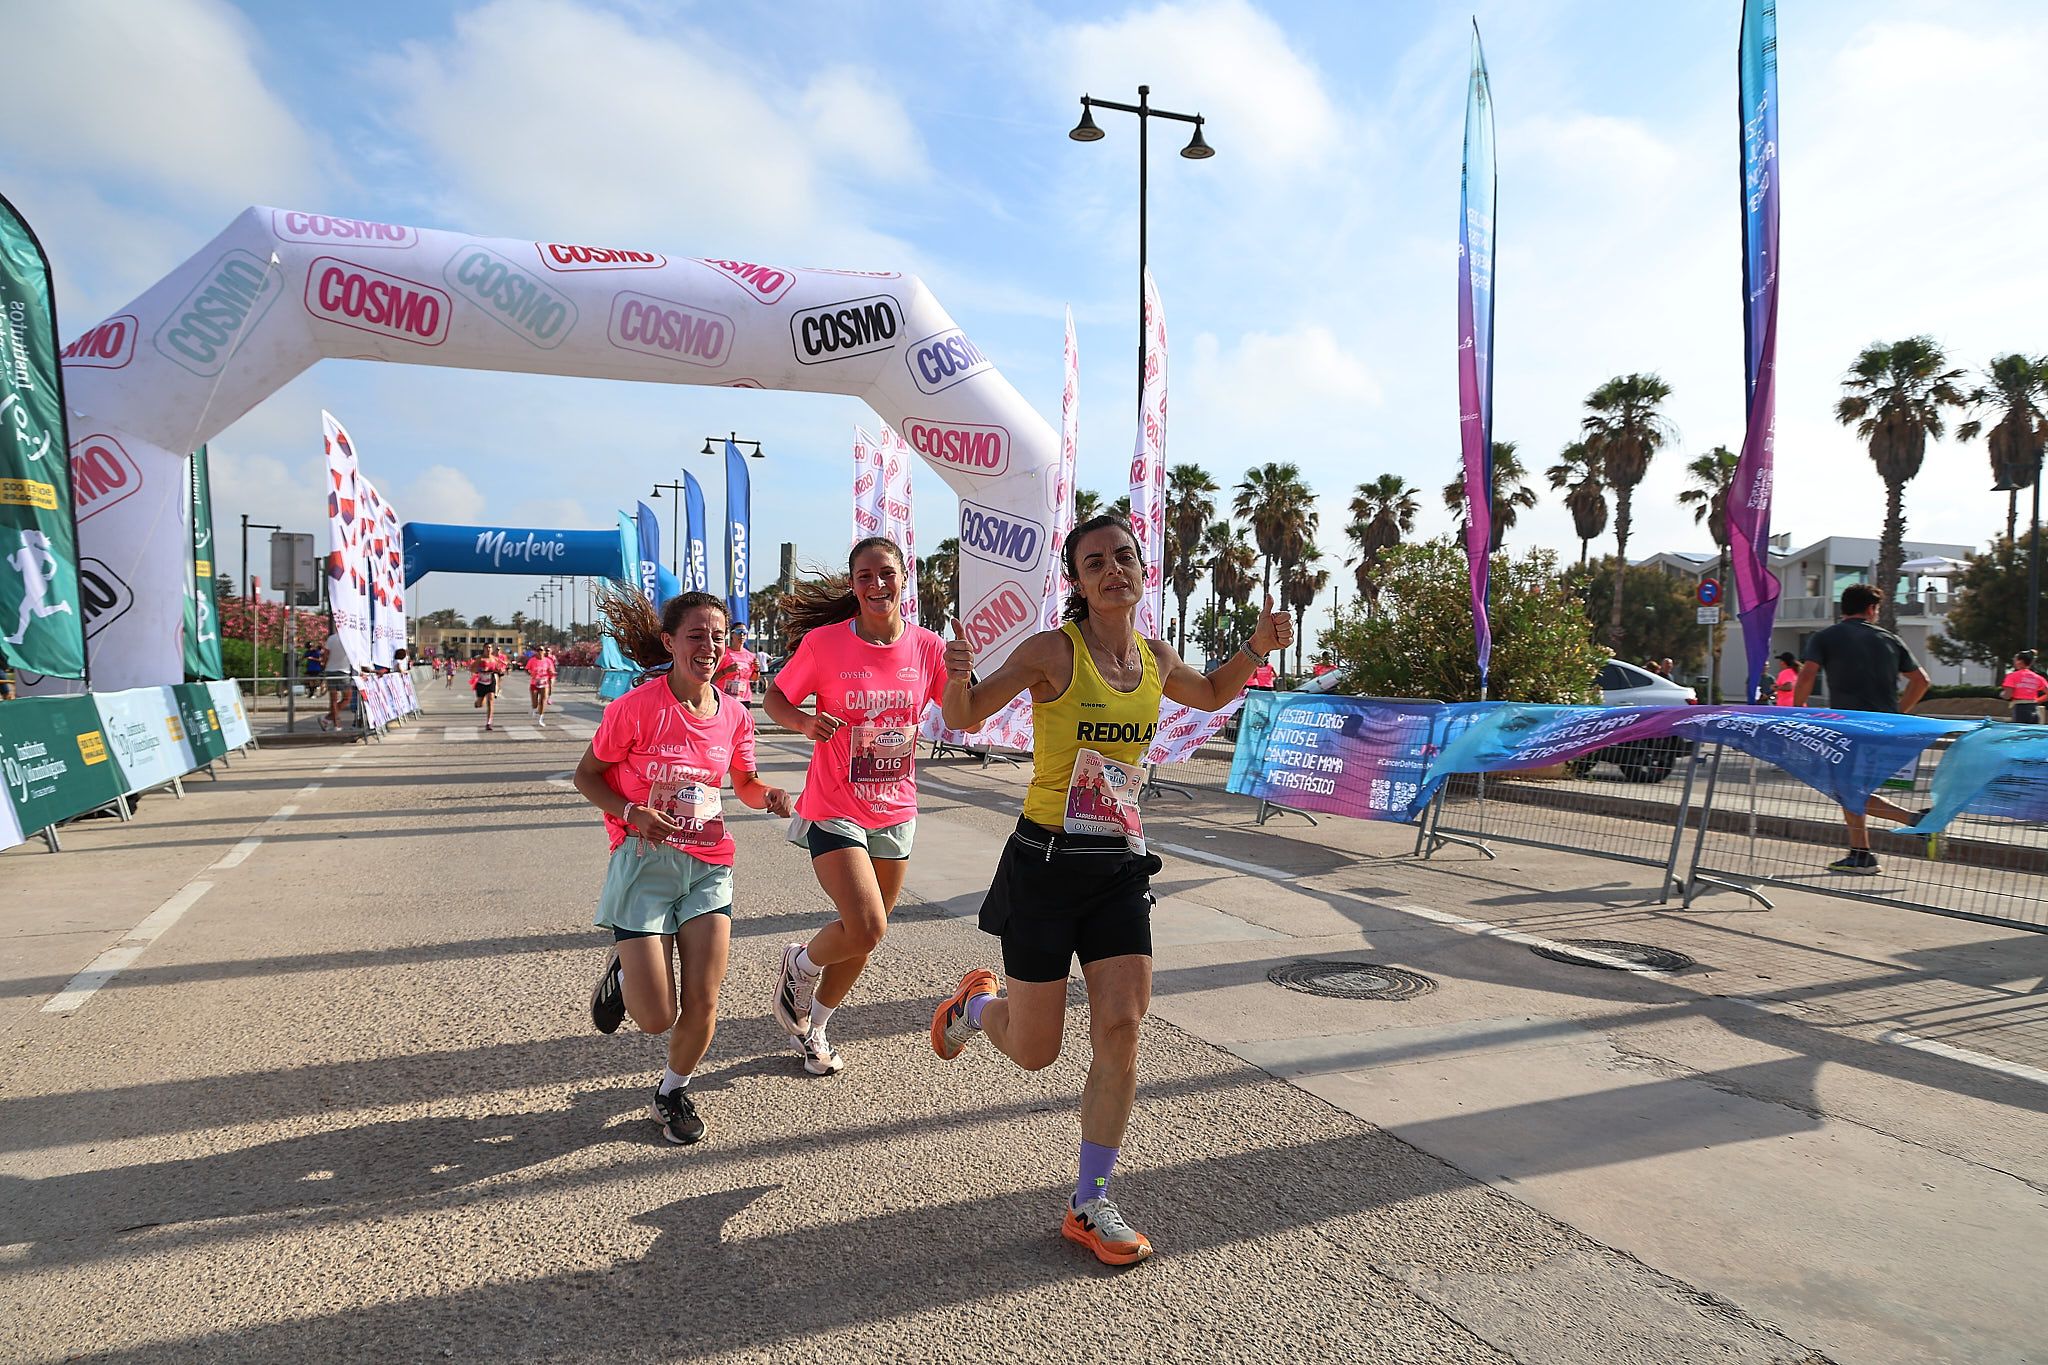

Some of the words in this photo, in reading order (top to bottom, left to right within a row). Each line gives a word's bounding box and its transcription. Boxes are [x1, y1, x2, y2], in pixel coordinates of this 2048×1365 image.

[167, 259, 271, 364] COSMO
[318, 266, 439, 337] COSMO
[457, 252, 567, 340] COSMO
[619, 299, 724, 360] COSMO
[801, 302, 896, 356] COSMO
[916, 336, 988, 385] COSM
[911, 424, 1001, 469] COSMO
[475, 530, 566, 568] Marlene
[961, 507, 1037, 563] COSMO
[964, 589, 1028, 655] OSMO
[840, 671, 873, 680] OYSHO
[845, 689, 915, 710] CARRERA
[1305, 732, 1319, 748] EL
[1838, 736, 1854, 752] AL
[875, 758, 902, 770] 016
[1085, 758, 1102, 767] SUM
[1301, 752, 1317, 770] DE
[1316, 755, 1344, 774] MAMA
[1266, 769, 1336, 795] METASTÁSICO
[1074, 822, 1105, 833] OYSHO
[1075, 812, 1098, 821] CARRERA
